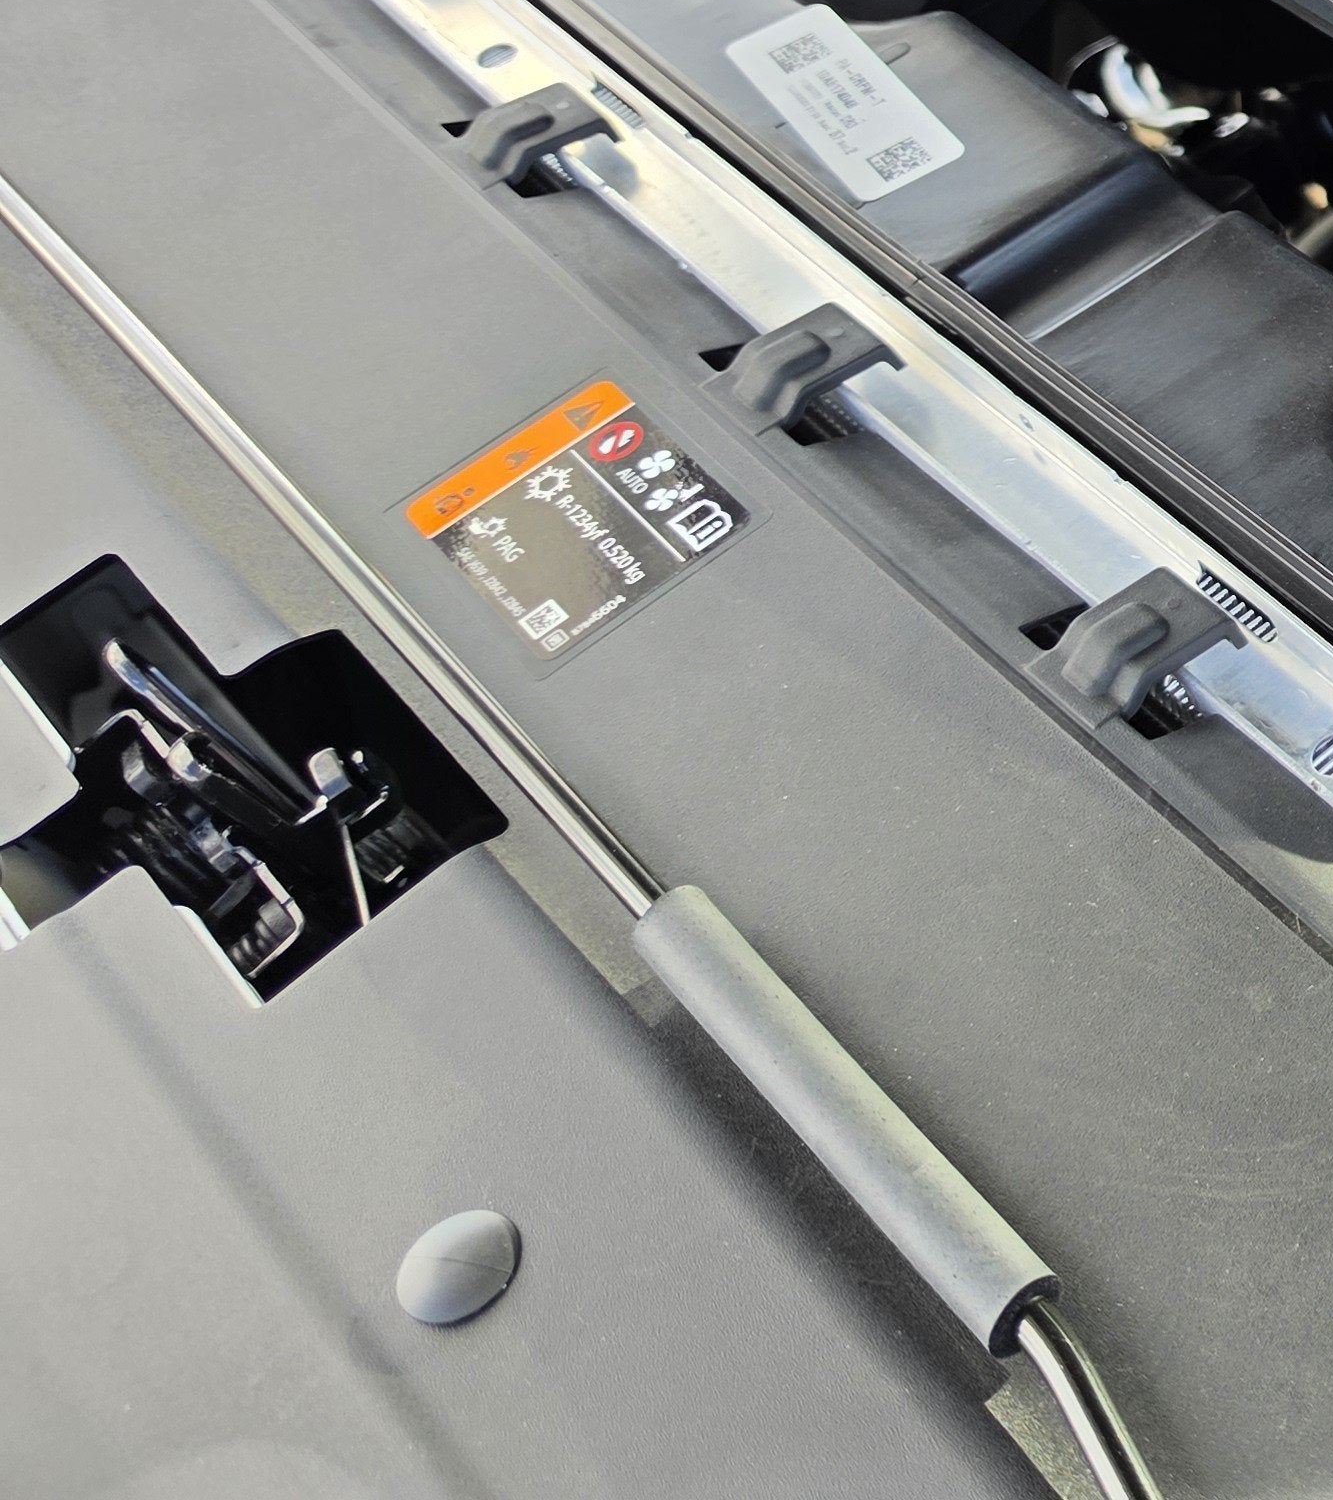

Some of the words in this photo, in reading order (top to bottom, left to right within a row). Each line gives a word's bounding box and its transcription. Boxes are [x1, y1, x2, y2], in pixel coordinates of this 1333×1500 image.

[615, 467, 649, 494] AUTO
[492, 535, 526, 563] PAG
[555, 494, 610, 541] R-1234yf
[622, 561, 646, 585] kg
